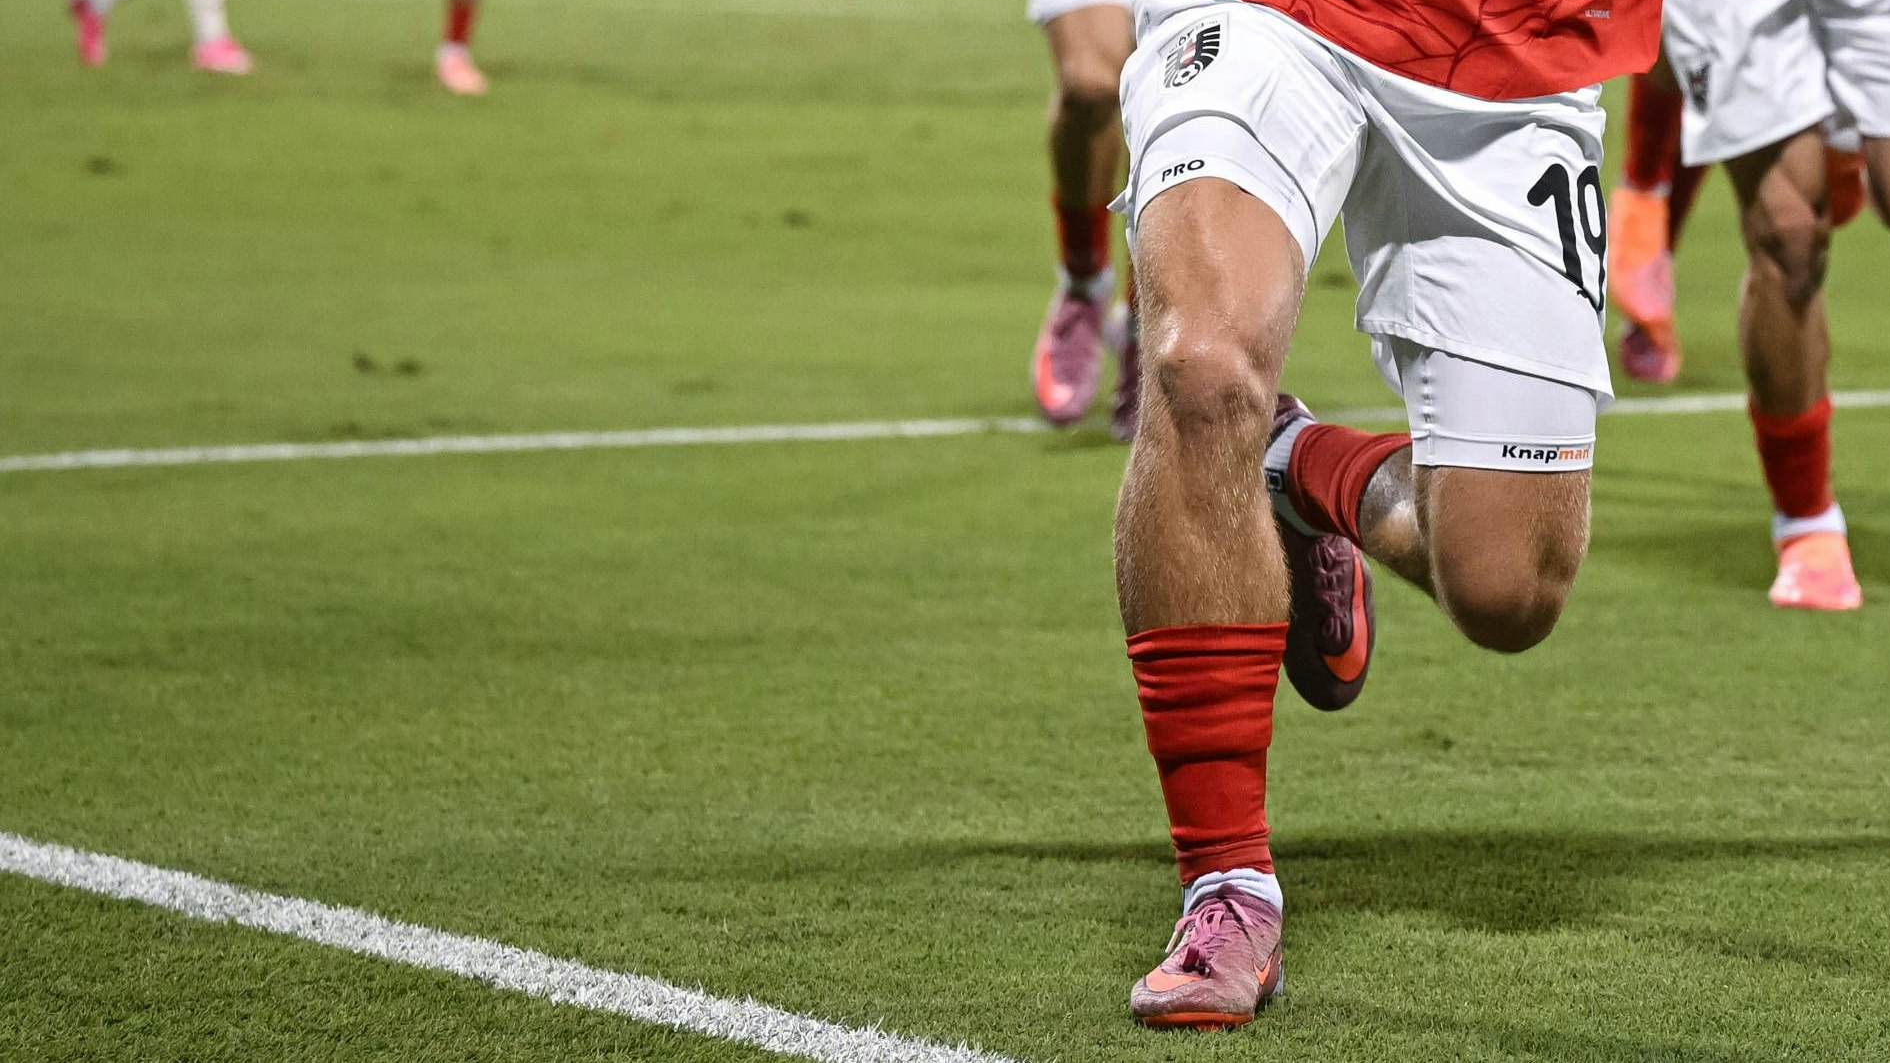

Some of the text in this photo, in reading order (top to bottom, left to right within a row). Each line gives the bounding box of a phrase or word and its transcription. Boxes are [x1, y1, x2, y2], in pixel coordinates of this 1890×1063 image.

[1161, 159, 1205, 183] PRO
[1527, 163, 1607, 311] 19
[1502, 444, 1589, 464] Knapman
